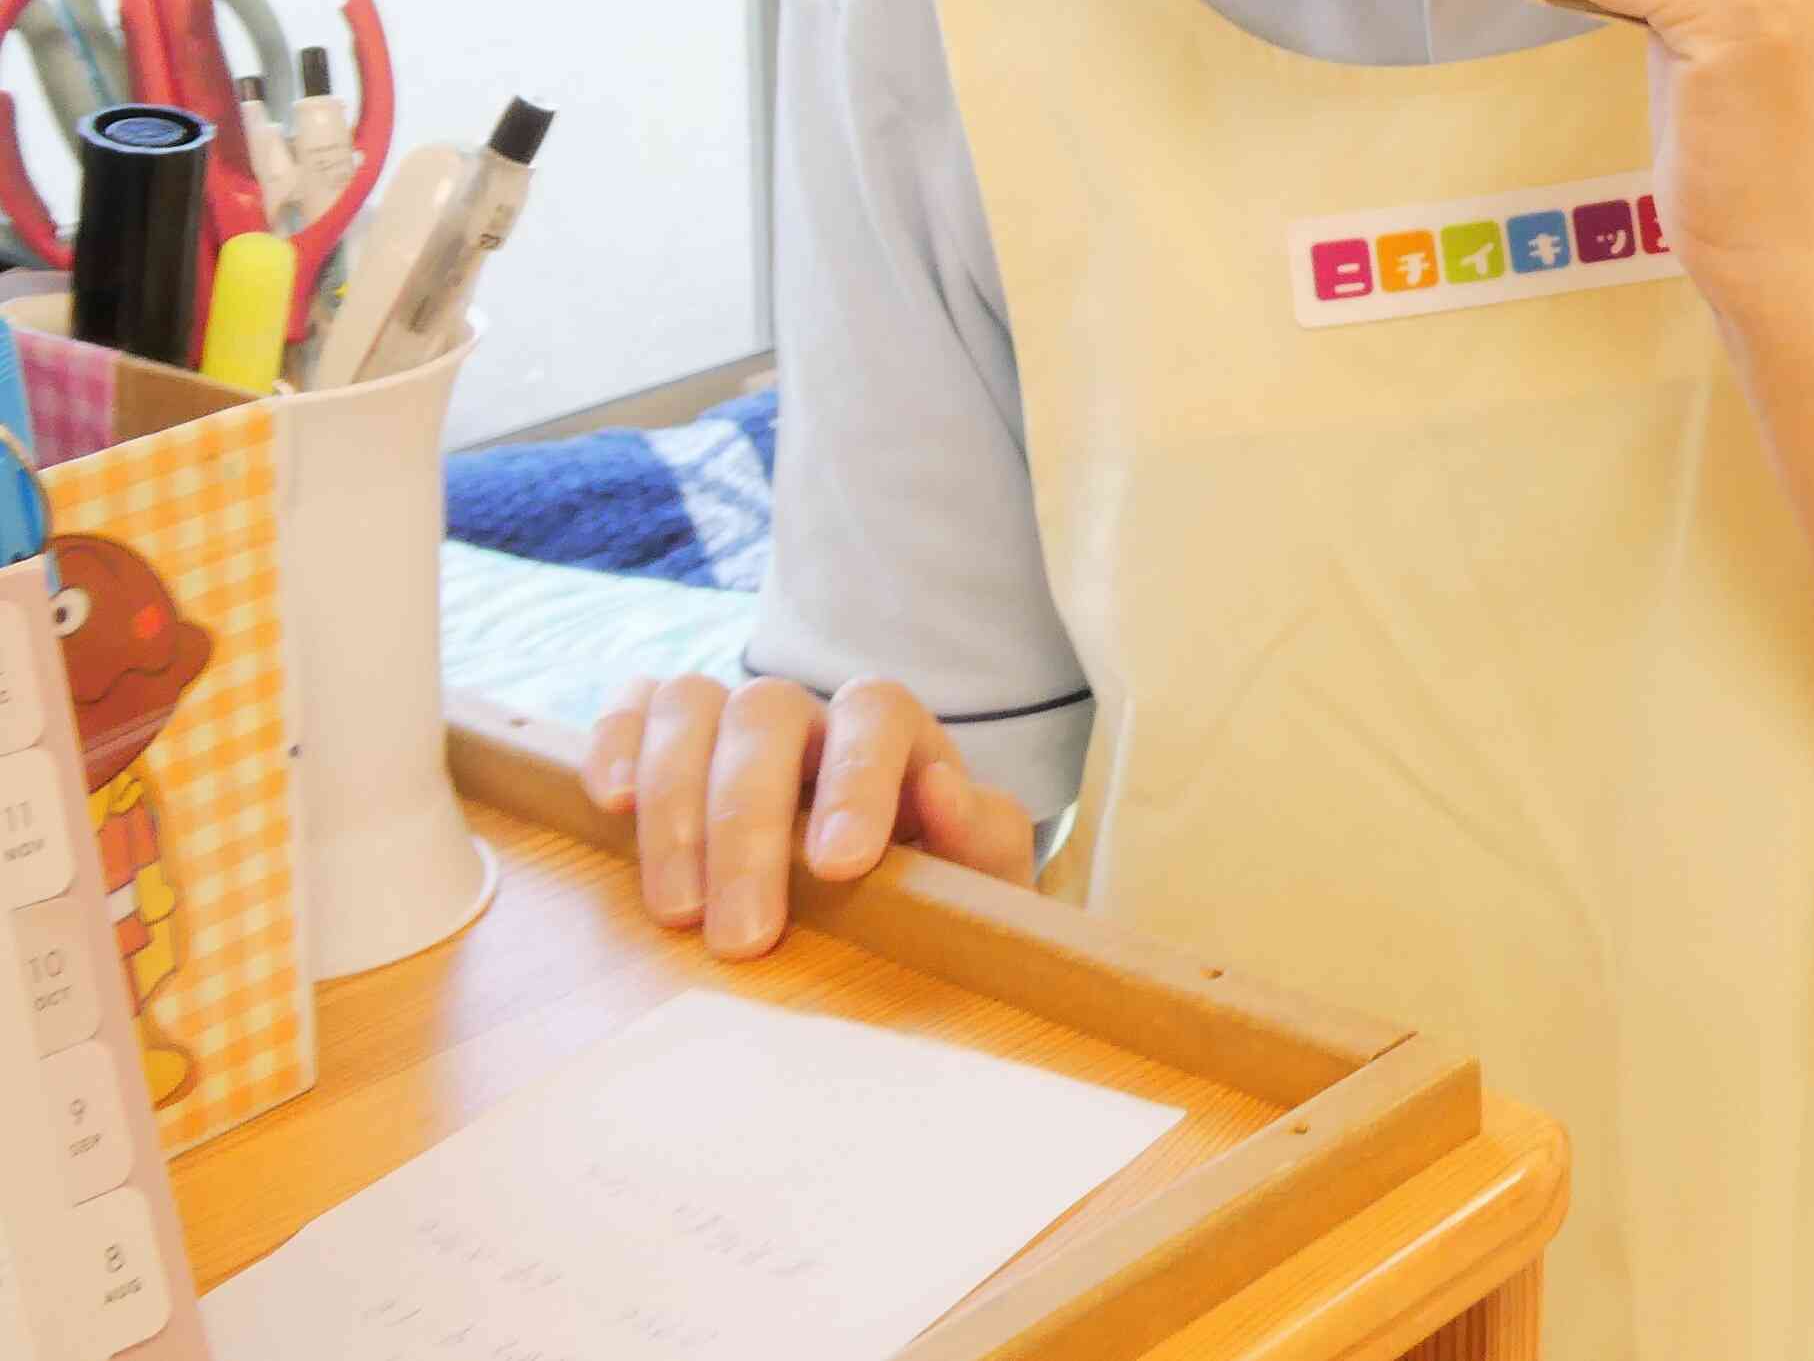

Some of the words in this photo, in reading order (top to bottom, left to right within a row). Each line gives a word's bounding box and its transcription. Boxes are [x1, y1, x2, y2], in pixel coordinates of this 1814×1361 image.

[1325, 215, 1667, 297] ニチイキッ
[27, 949, 64, 977] 10
[69, 1097, 87, 1125] 9
[105, 1243, 126, 1273] 8
